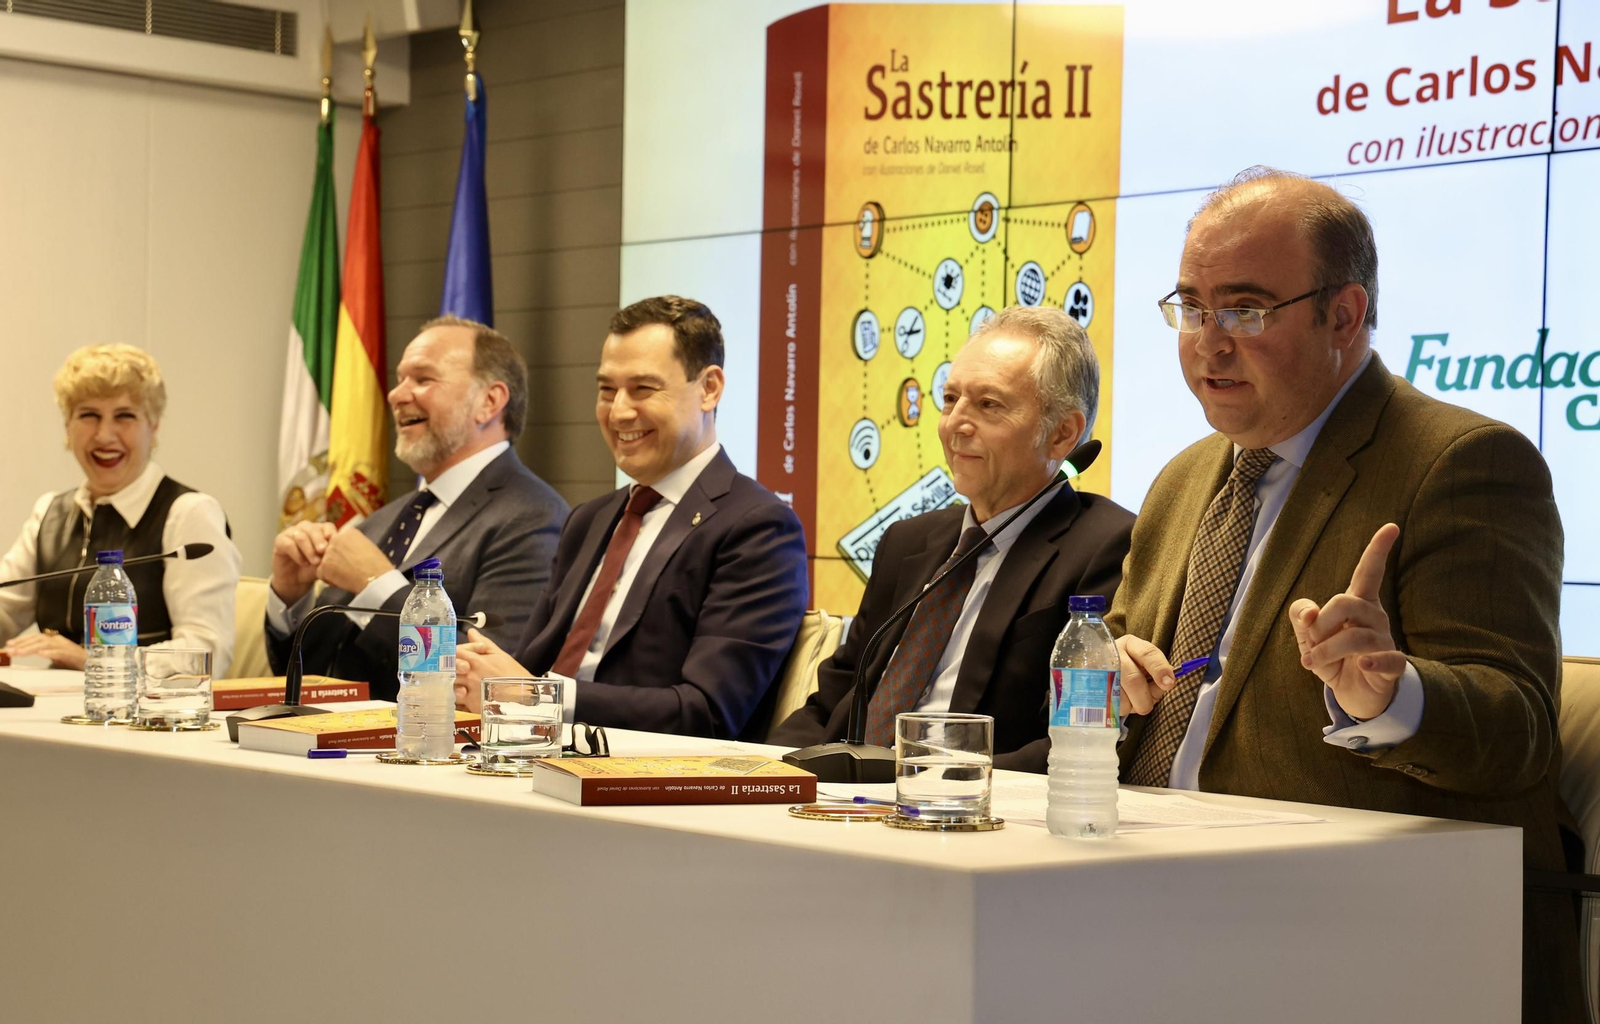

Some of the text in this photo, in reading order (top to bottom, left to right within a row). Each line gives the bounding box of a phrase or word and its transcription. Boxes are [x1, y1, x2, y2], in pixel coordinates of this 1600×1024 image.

[891, 49, 909, 73] La
[1316, 42, 1600, 116] de Carlos N
[864, 61, 1093, 121] Sastrería II
[863, 137, 879, 155] de
[883, 136, 920, 155] Carlos
[924, 136, 972, 154] Navarro
[1347, 137, 1404, 165] con
[783, 283, 798, 474] de Carlos Navarro Antolín
[470, 725, 480, 735] La
[730, 785, 739, 796] II
[741, 784, 786, 796] Sastrería
[788, 784, 801, 795] La
